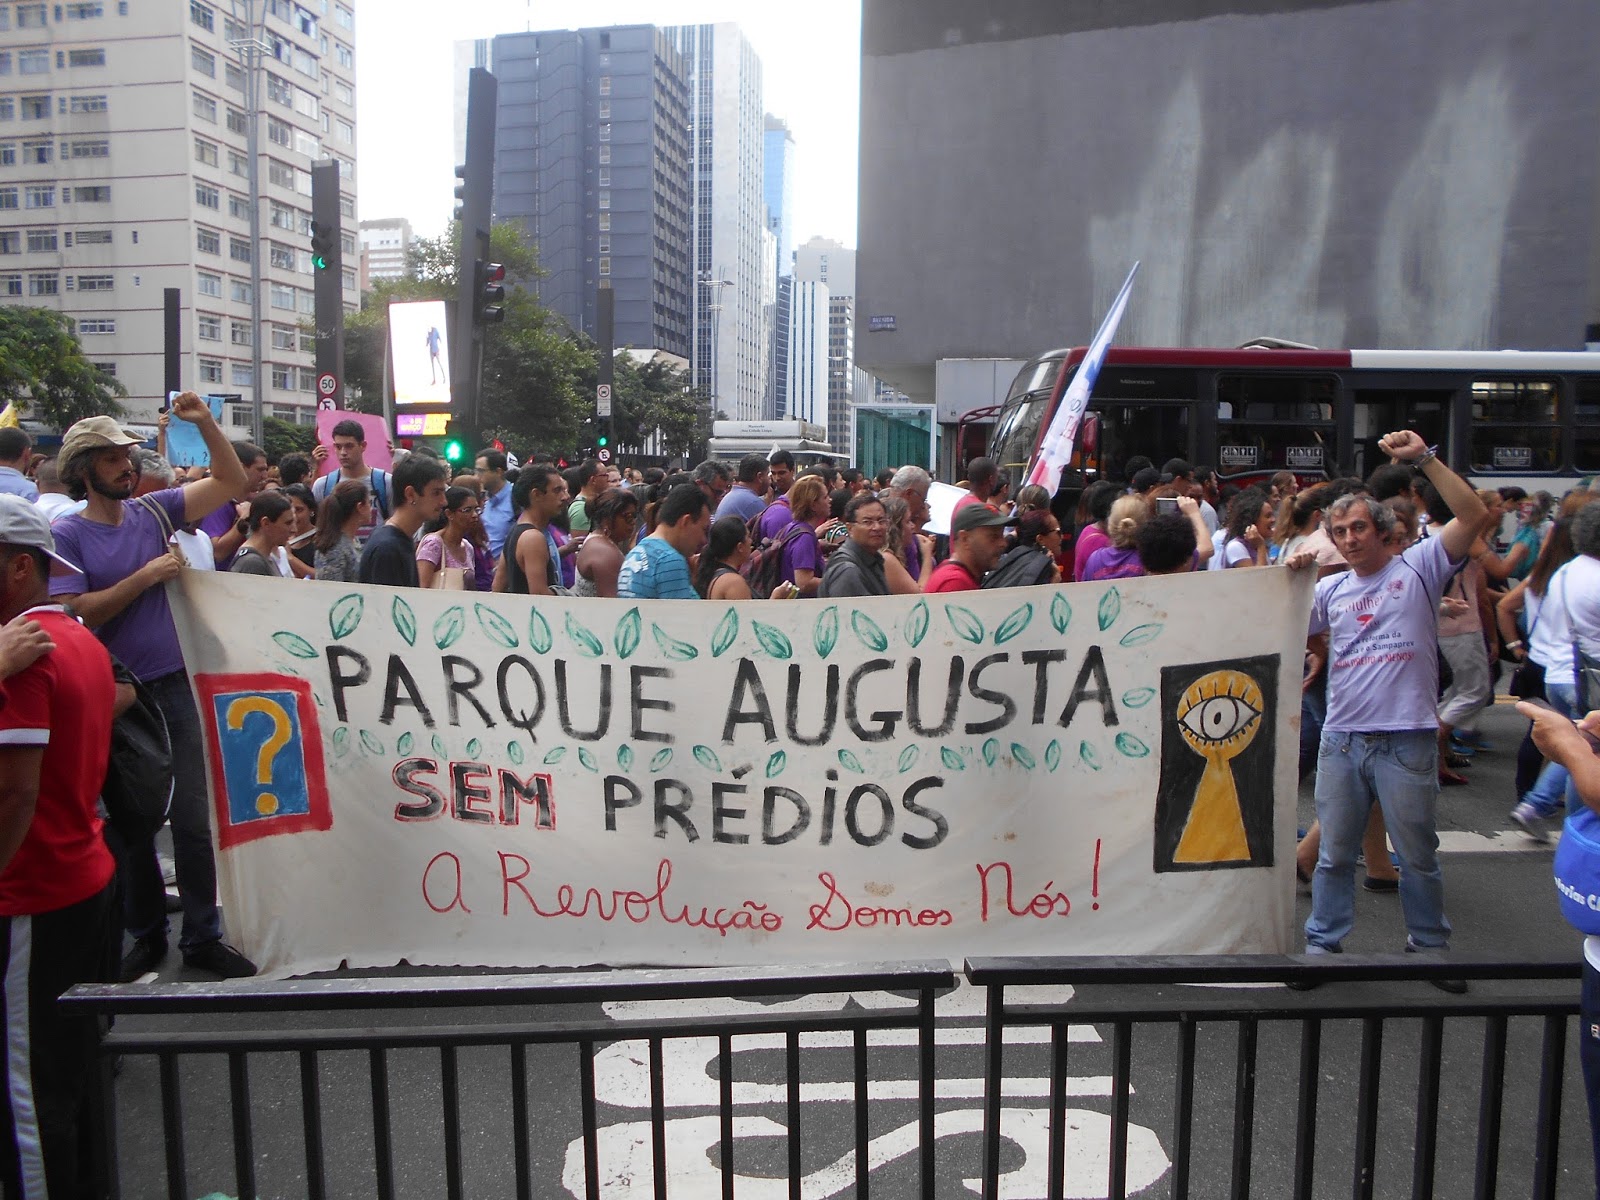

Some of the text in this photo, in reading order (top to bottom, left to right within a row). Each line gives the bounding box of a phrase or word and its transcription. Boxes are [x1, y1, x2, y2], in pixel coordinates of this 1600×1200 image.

[321, 378, 335, 390] 50
[325, 645, 1120, 747] PARQUE AUGUSTA
[392, 757, 950, 851] SEM PRÉDIOS
[497, 850, 784, 937] Revolução
[805, 871, 954, 932] Somos
